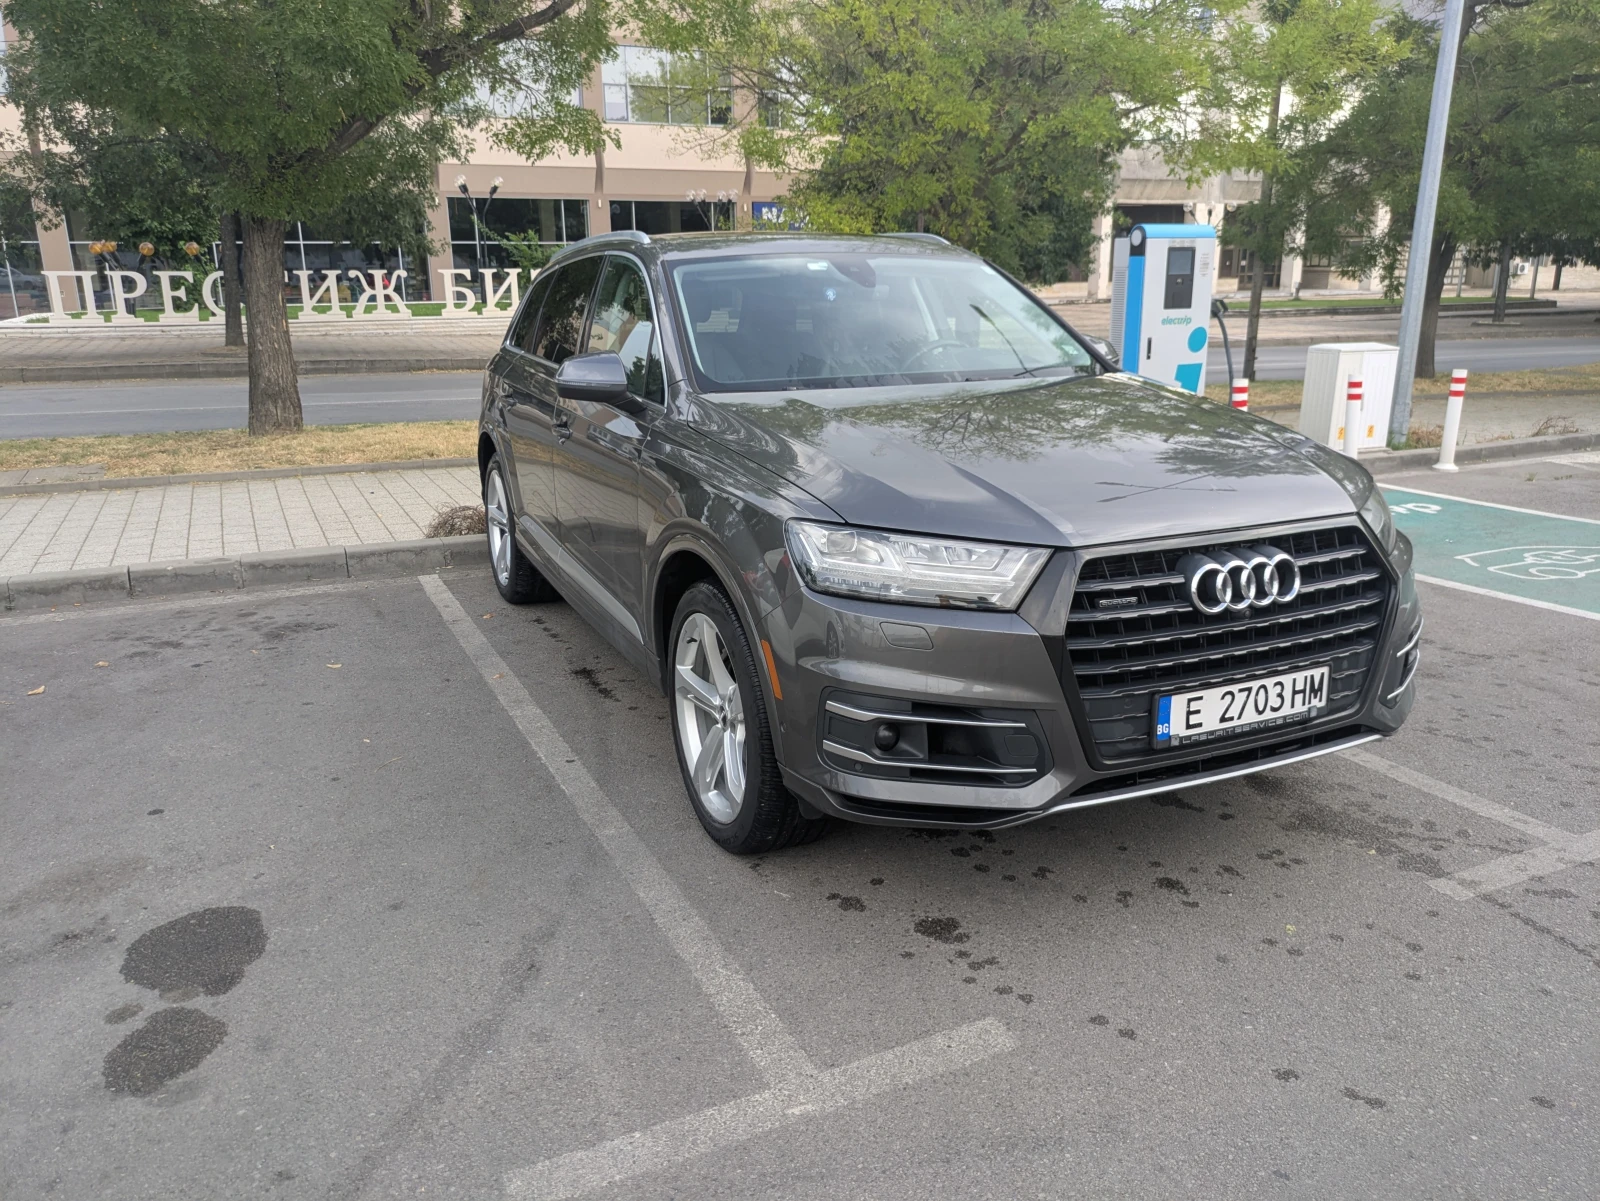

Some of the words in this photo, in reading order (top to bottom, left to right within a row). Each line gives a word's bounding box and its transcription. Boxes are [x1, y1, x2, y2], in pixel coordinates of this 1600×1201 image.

[41, 269, 412, 318] ПРЕСИЖ
[437, 267, 541, 316] БИ
[1161, 315, 1192, 326] electrip
[1185, 695, 1204, 731] E
[1156, 723, 1170, 735] BG
